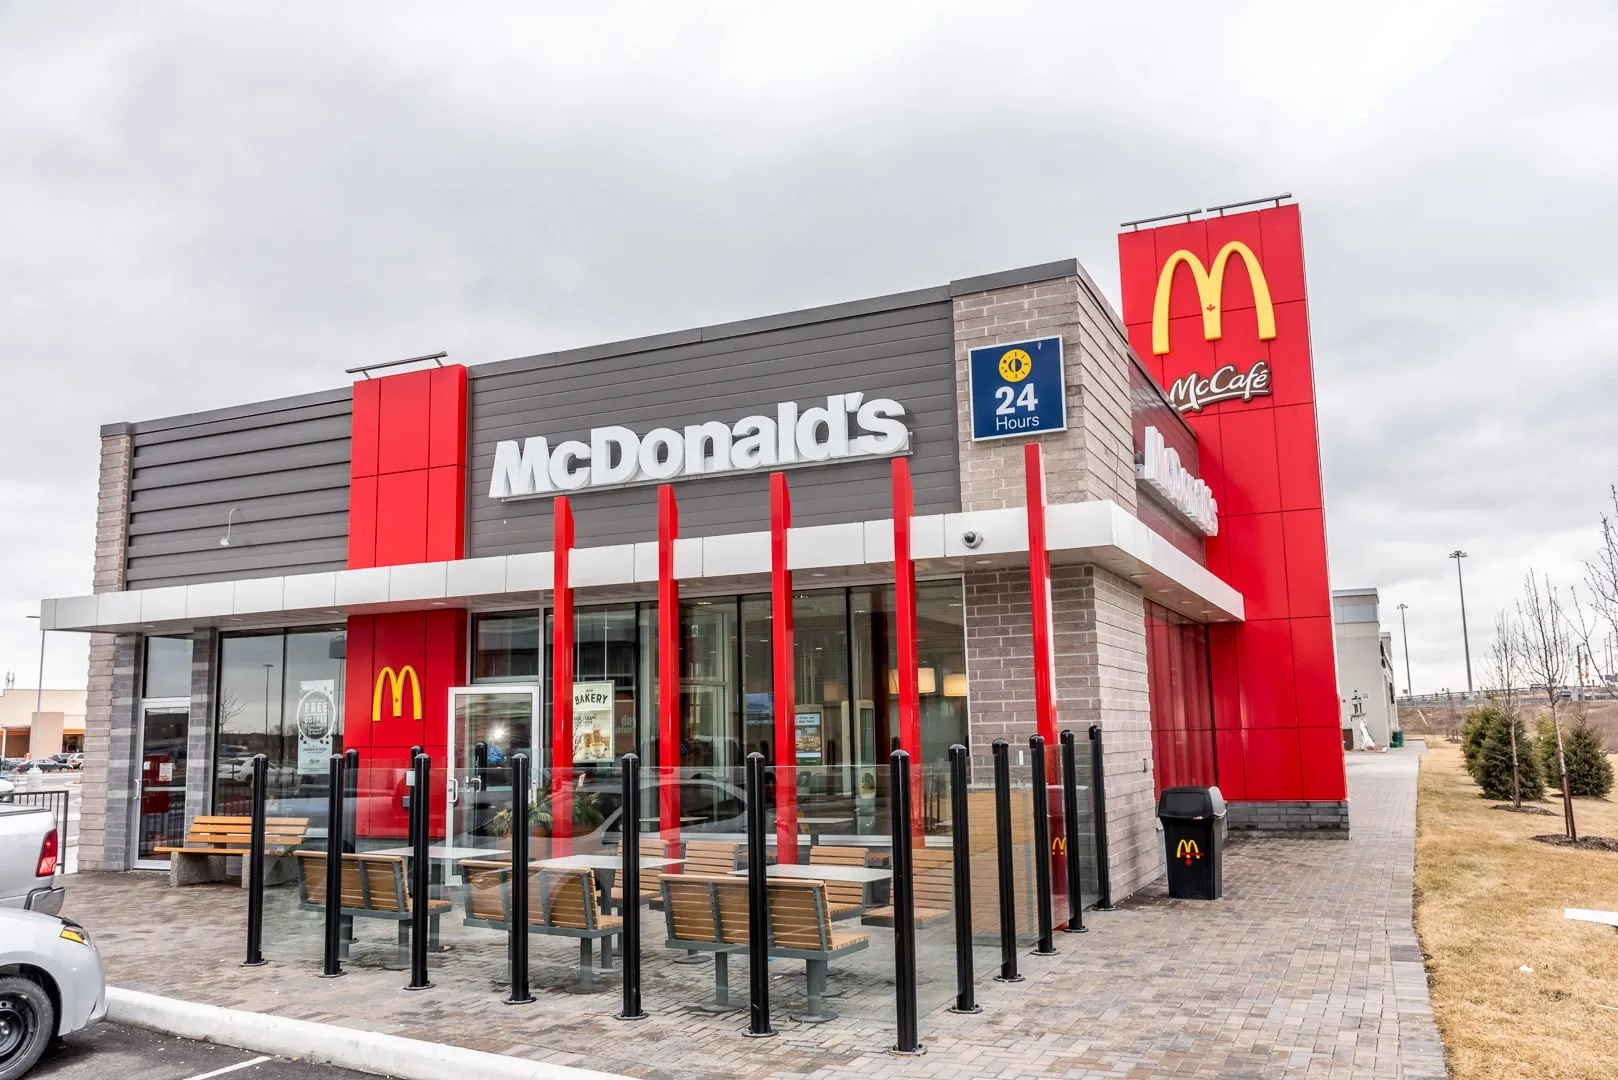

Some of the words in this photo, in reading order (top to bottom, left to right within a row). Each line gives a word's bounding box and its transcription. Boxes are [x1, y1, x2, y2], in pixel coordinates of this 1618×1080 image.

[1169, 361, 1269, 410] McCafé
[995, 383, 1039, 416] 24
[996, 415, 1040, 431] Hours
[488, 391, 907, 498] McDonald's
[304, 702, 328, 713] FREE
[574, 693, 609, 706] BAKERY
